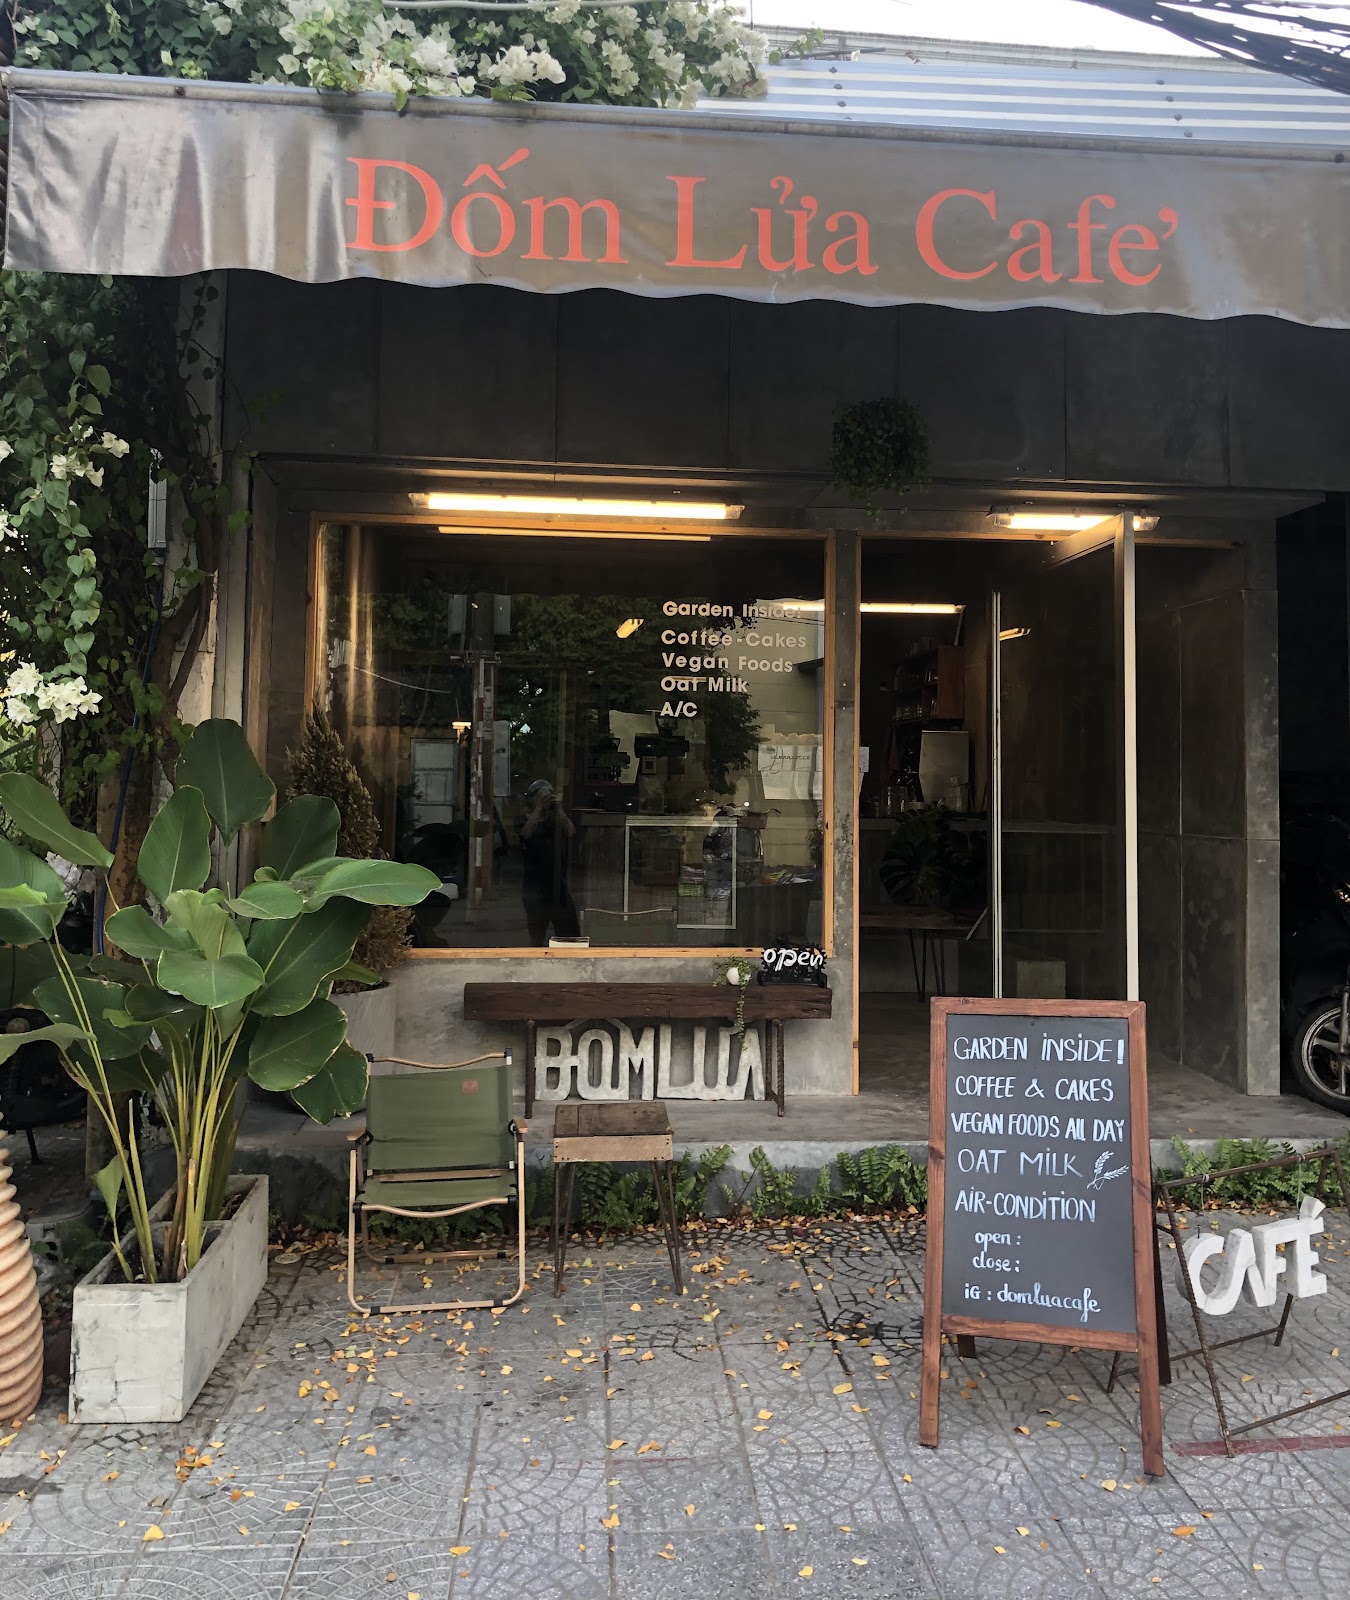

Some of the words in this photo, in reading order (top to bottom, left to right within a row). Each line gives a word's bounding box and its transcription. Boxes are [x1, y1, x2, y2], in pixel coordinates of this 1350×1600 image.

[344, 147, 630, 264] Đốm
[667, 175, 878, 275] Lửa
[663, 601, 733, 617] Garden
[662, 653, 729, 672] Vegan
[739, 656, 793, 673] Foods
[660, 676, 698, 692] Oat
[708, 677, 748, 692] Milk
[660, 701, 697, 717] A/C
[763, 948, 824, 972] open
[953, 1036, 1028, 1061] GARDEN
[955, 1074, 1017, 1099] COFFEE
[1024, 1078, 1045, 1099] &
[1055, 1078, 1114, 1102] CAKES
[950, 1111, 1004, 1135] VEGAN
[1009, 1113, 1061, 1138] FOODS
[1092, 1118, 1125, 1143] DAY
[957, 1148, 1008, 1174] OAT
[996, 1282, 1102, 1323] domluacafe
